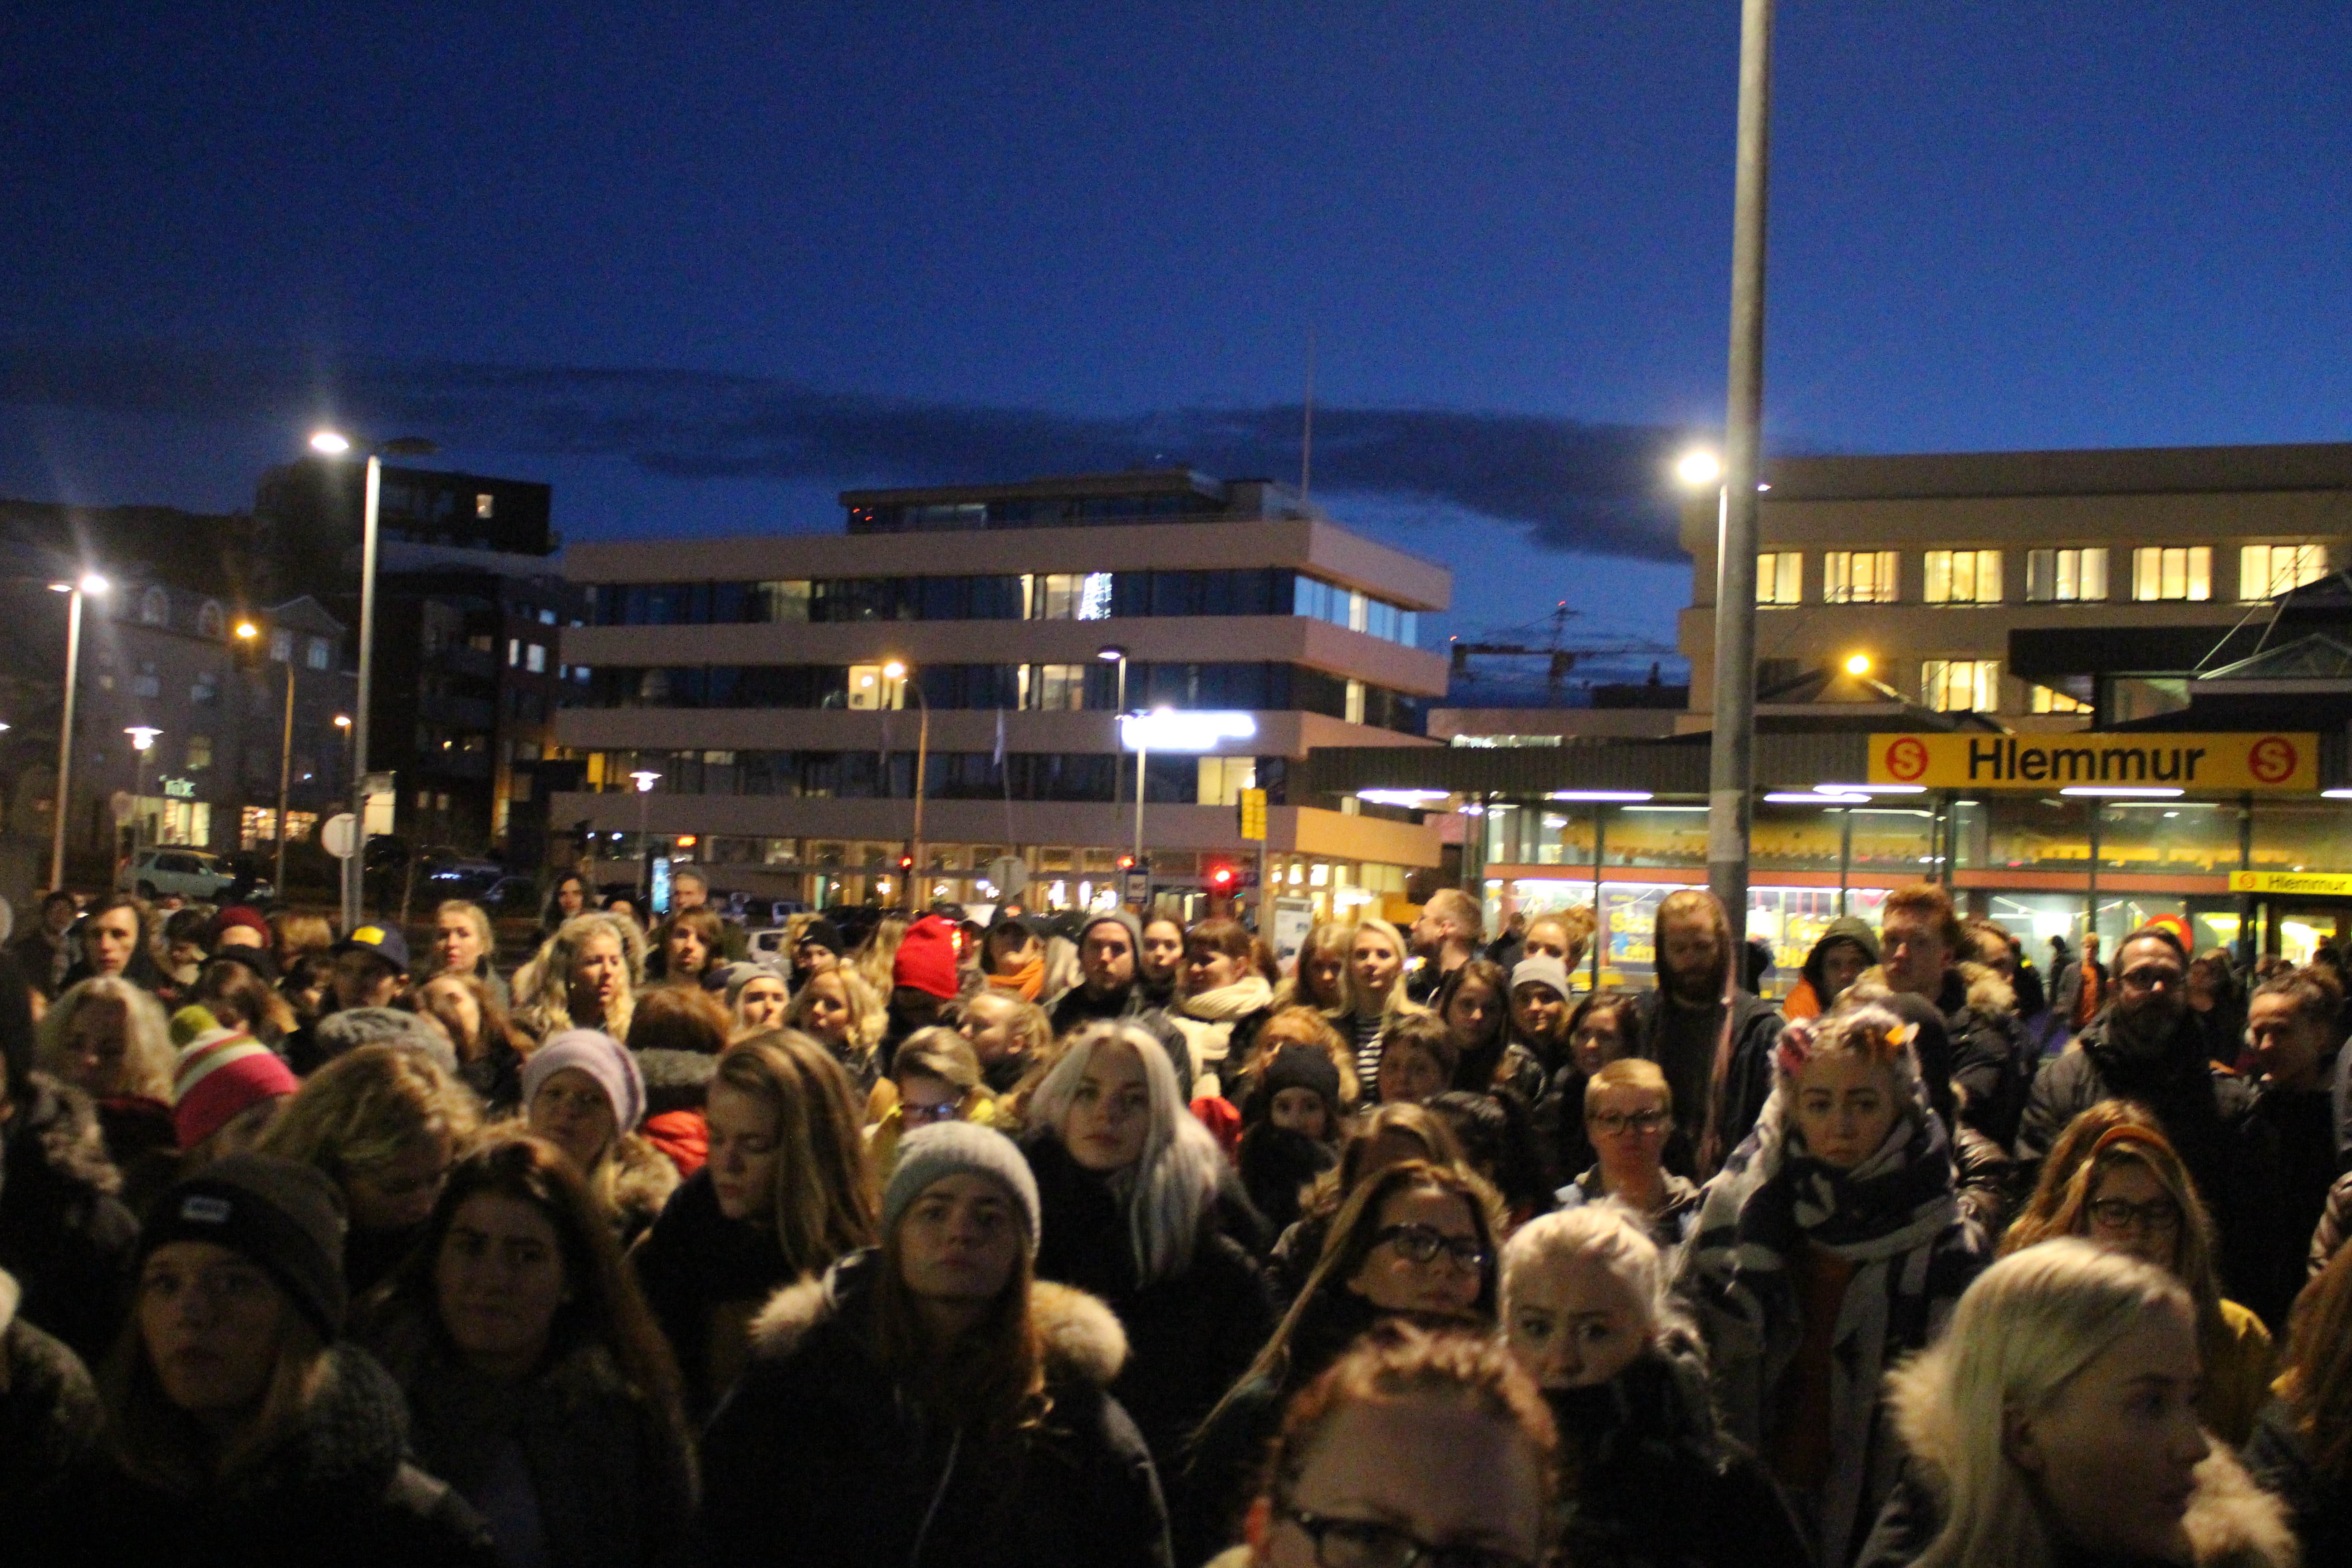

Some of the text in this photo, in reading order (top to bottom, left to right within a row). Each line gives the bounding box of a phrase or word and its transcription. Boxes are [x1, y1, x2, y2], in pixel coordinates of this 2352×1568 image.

[1891, 738, 2291, 781] S Hlemmur S
[2269, 875, 2347, 892] Hlemmur
